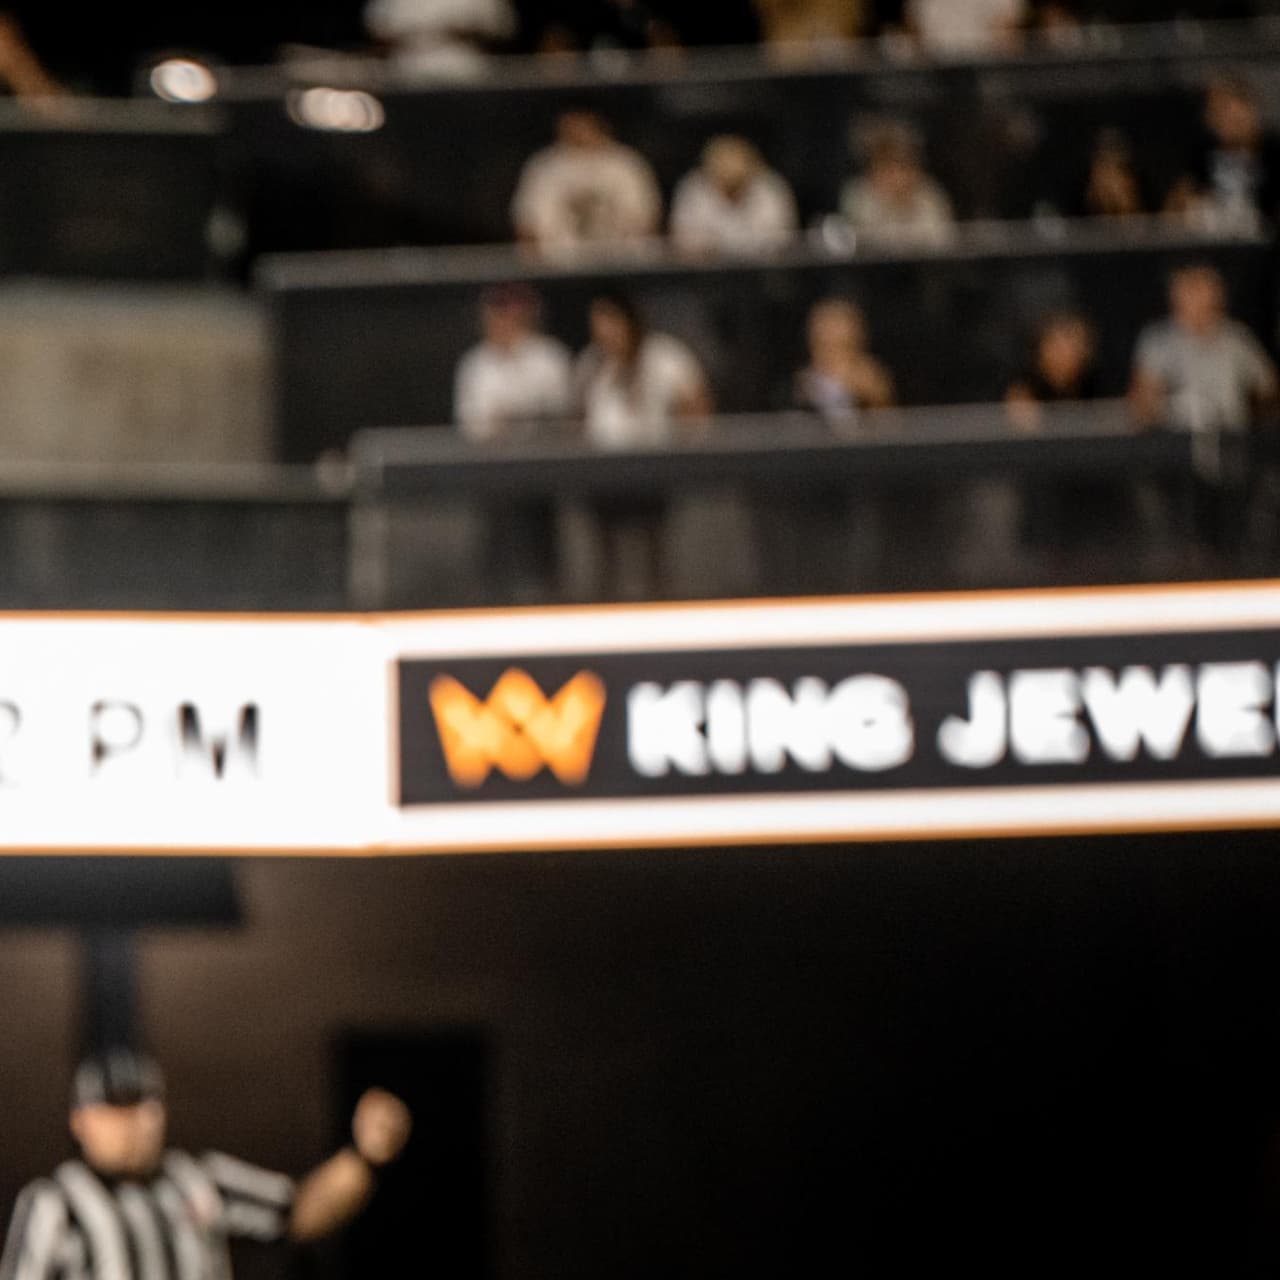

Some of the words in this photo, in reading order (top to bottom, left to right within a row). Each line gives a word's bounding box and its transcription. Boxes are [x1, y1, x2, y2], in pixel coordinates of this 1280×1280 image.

[88, 698, 262, 782] PM
[627, 674, 913, 777] KING
[937, 660, 1280, 767] JEWE
